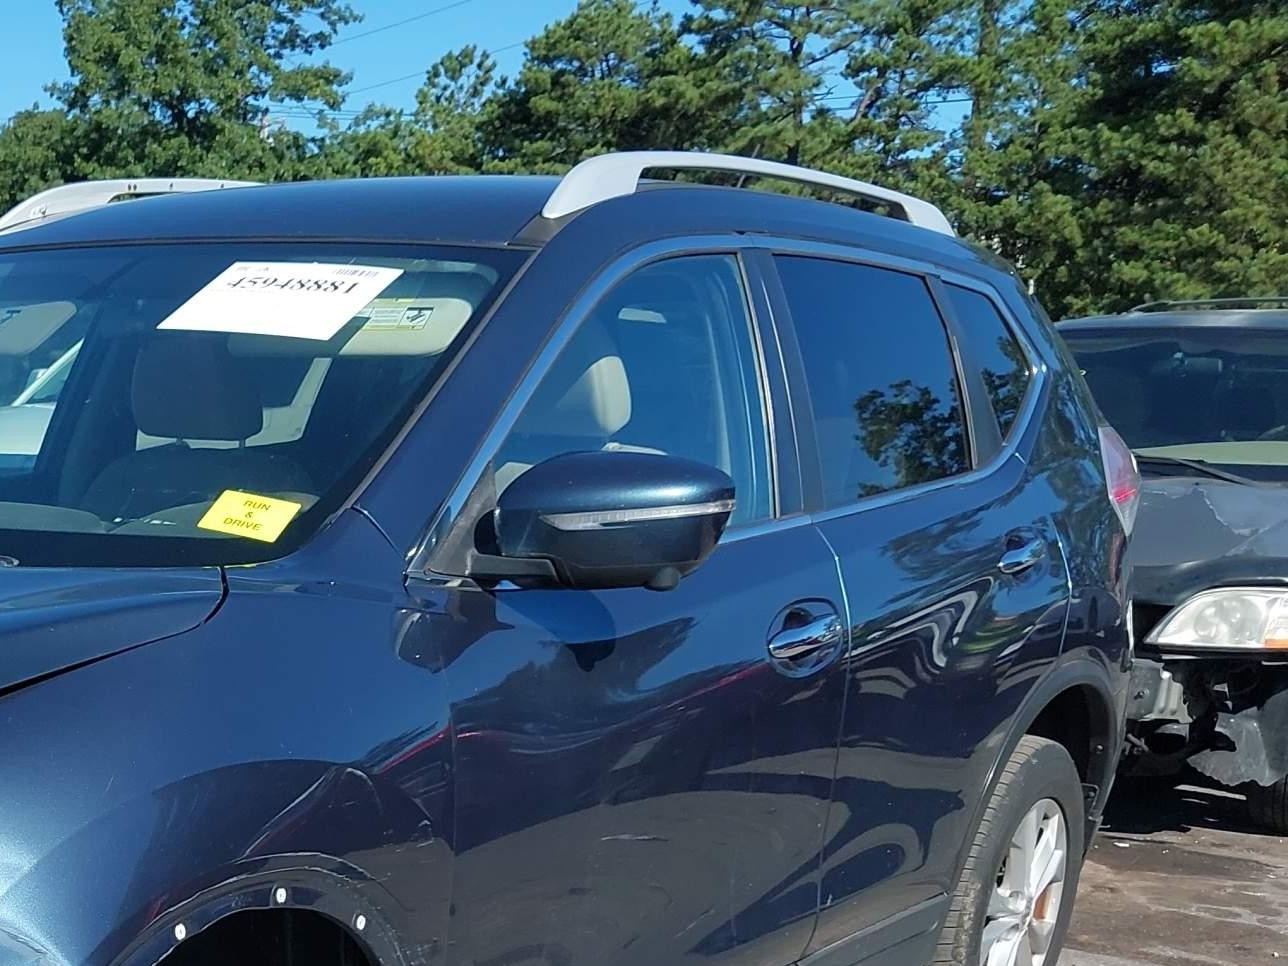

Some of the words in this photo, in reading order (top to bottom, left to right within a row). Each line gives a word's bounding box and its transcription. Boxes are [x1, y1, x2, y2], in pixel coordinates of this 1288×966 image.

[227, 276, 360, 294] 45948881
[242, 499, 272, 512] RUN
[244, 511, 254, 519] &
[223, 517, 263, 531] DRIVE
